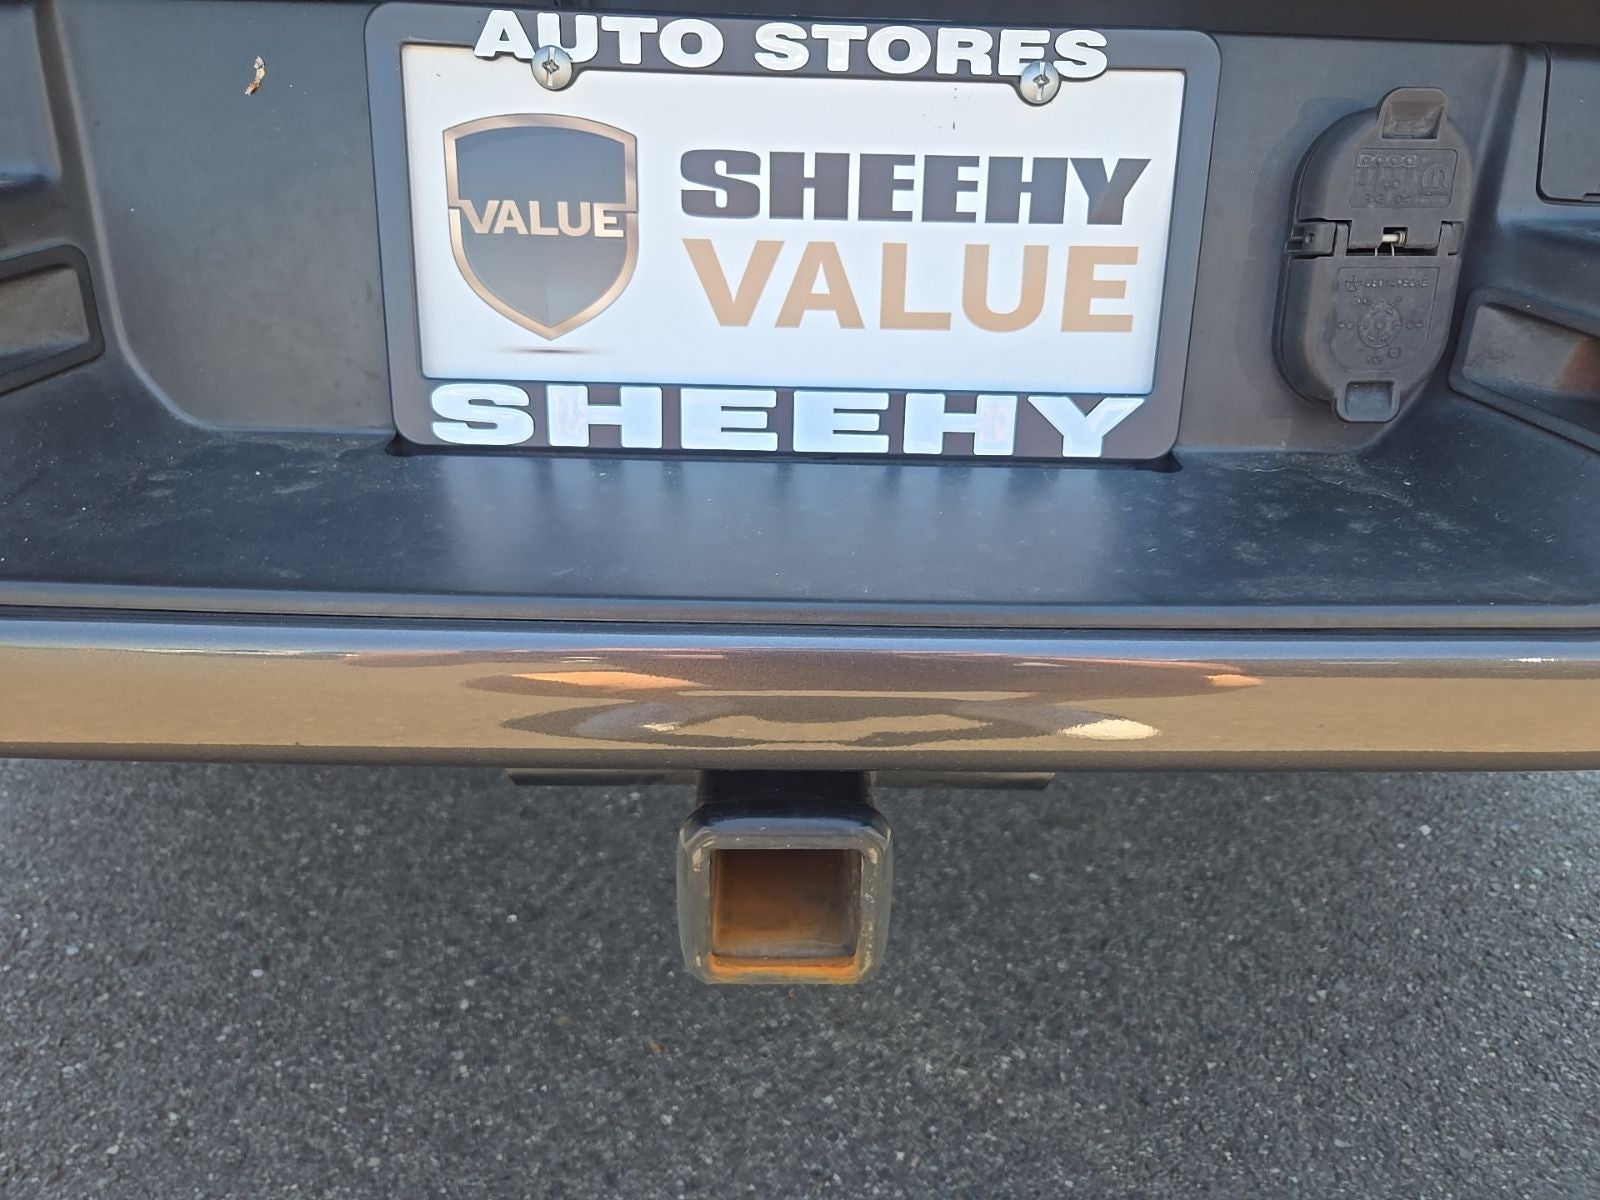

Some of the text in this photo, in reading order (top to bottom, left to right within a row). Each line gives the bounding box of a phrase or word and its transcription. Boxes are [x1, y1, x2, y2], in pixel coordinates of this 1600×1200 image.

[474, 9, 1109, 79] AUTO STORES
[463, 200, 625, 238] VALUE
[681, 150, 1150, 225] SHEEHY
[684, 239, 1138, 333] VALUE
[430, 384, 1144, 458] SHEEHY
